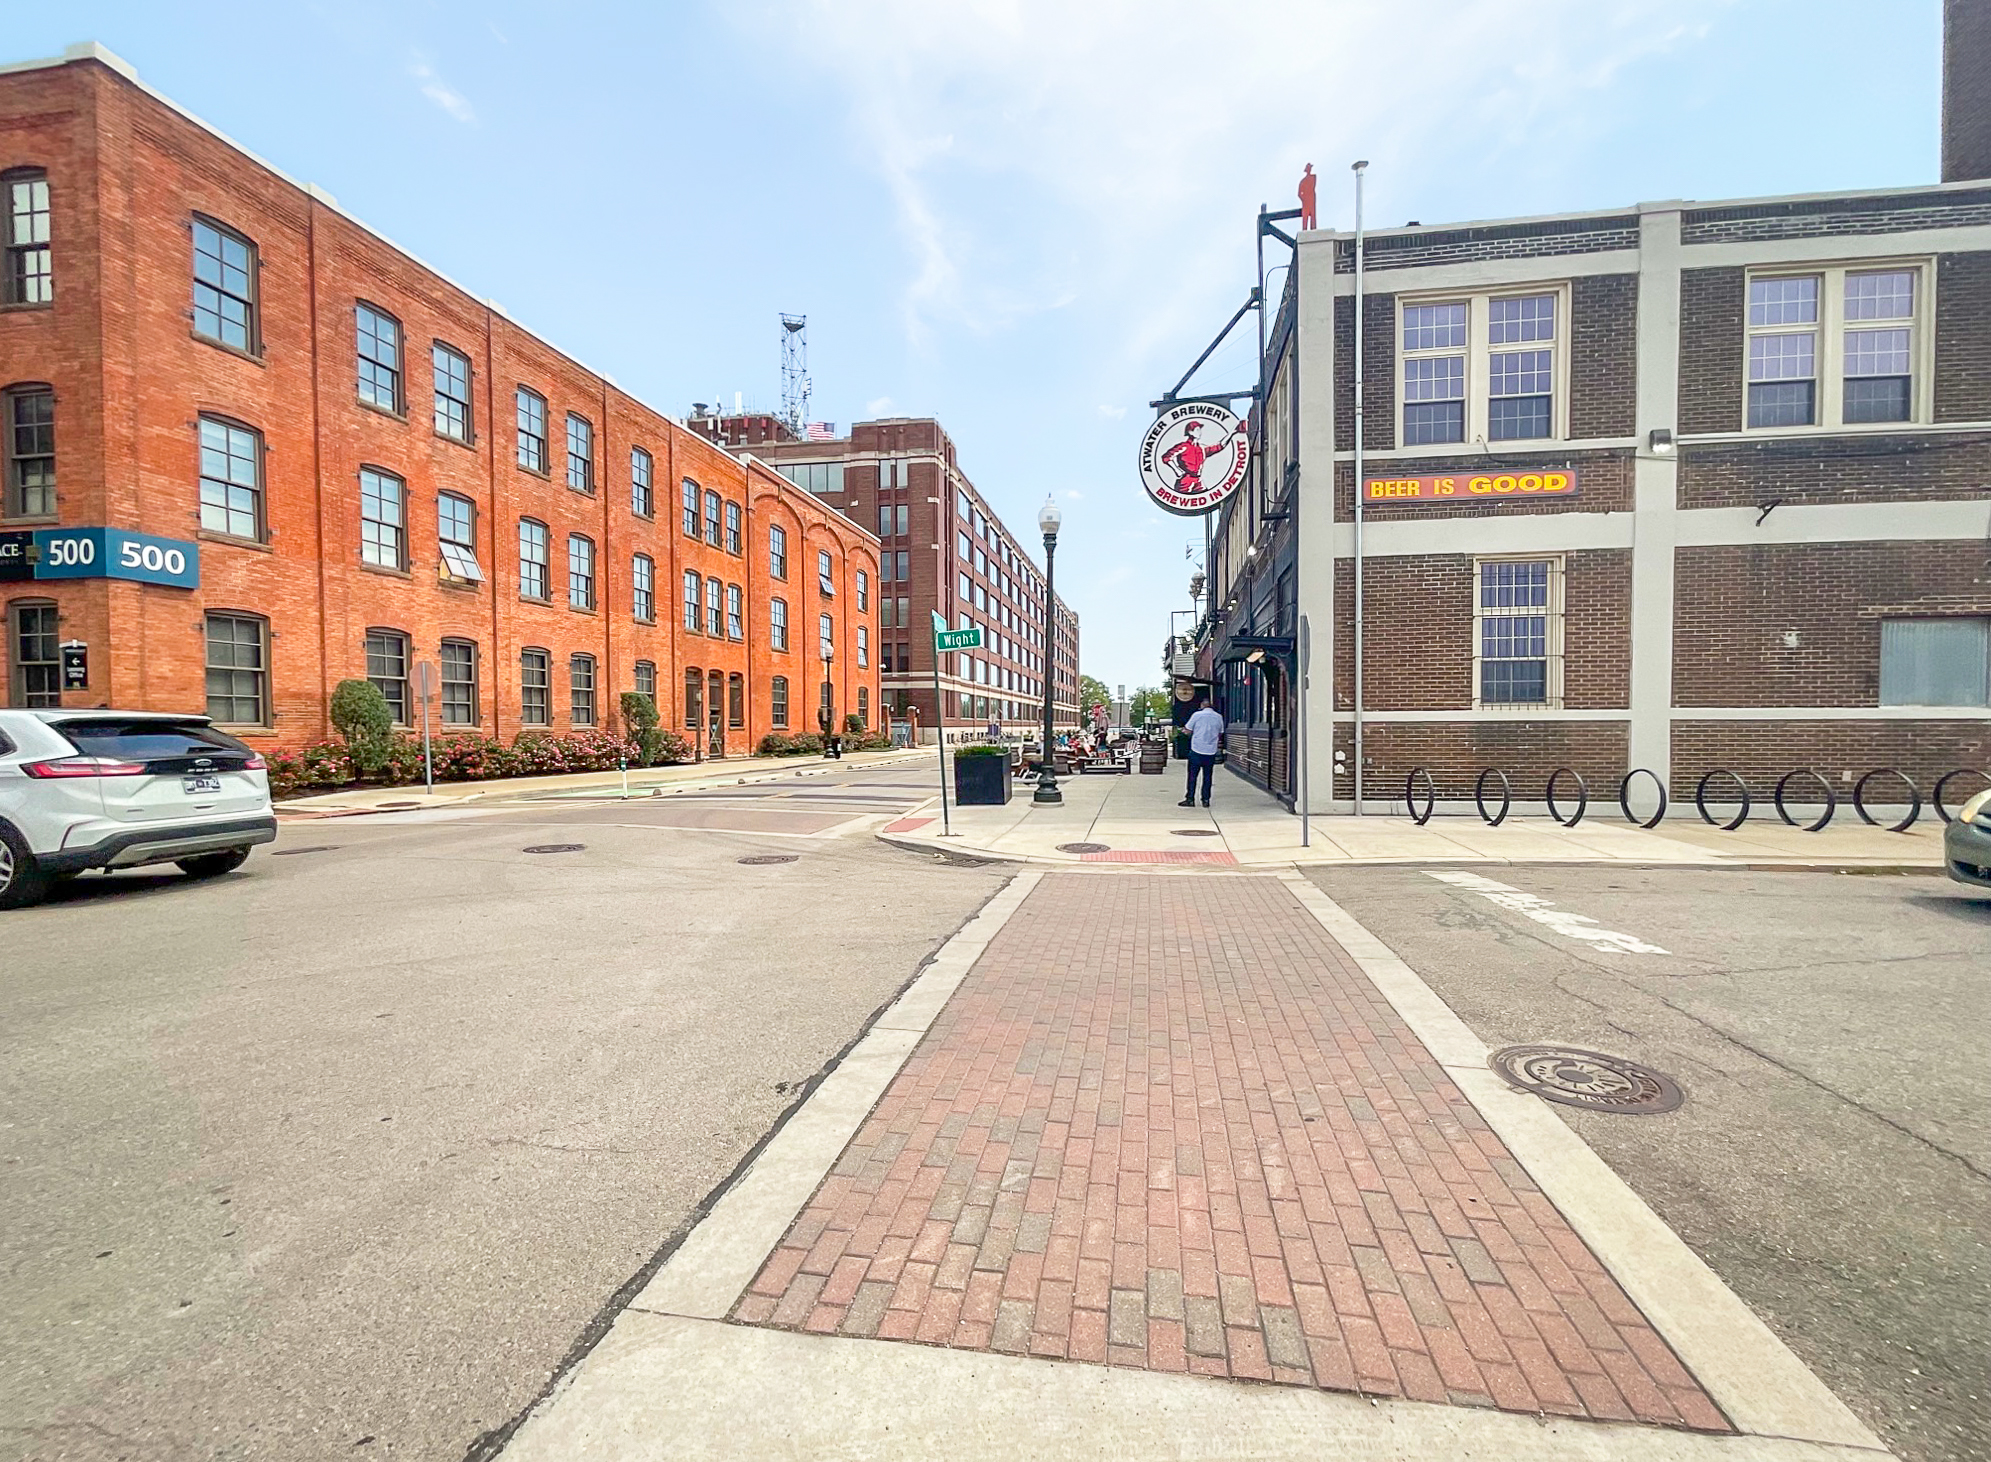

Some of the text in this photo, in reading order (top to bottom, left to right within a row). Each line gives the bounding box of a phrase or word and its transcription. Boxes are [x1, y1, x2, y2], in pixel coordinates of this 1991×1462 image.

[1143, 405, 1230, 473] ATWATER BREWERY
[1156, 440, 1247, 507] BREWED IN DETROIT
[1370, 473, 1568, 498] BEER IS GOOD
[49, 538, 95, 566] 500
[120, 541, 186, 575] 500
[943, 632, 975, 648] Wight
